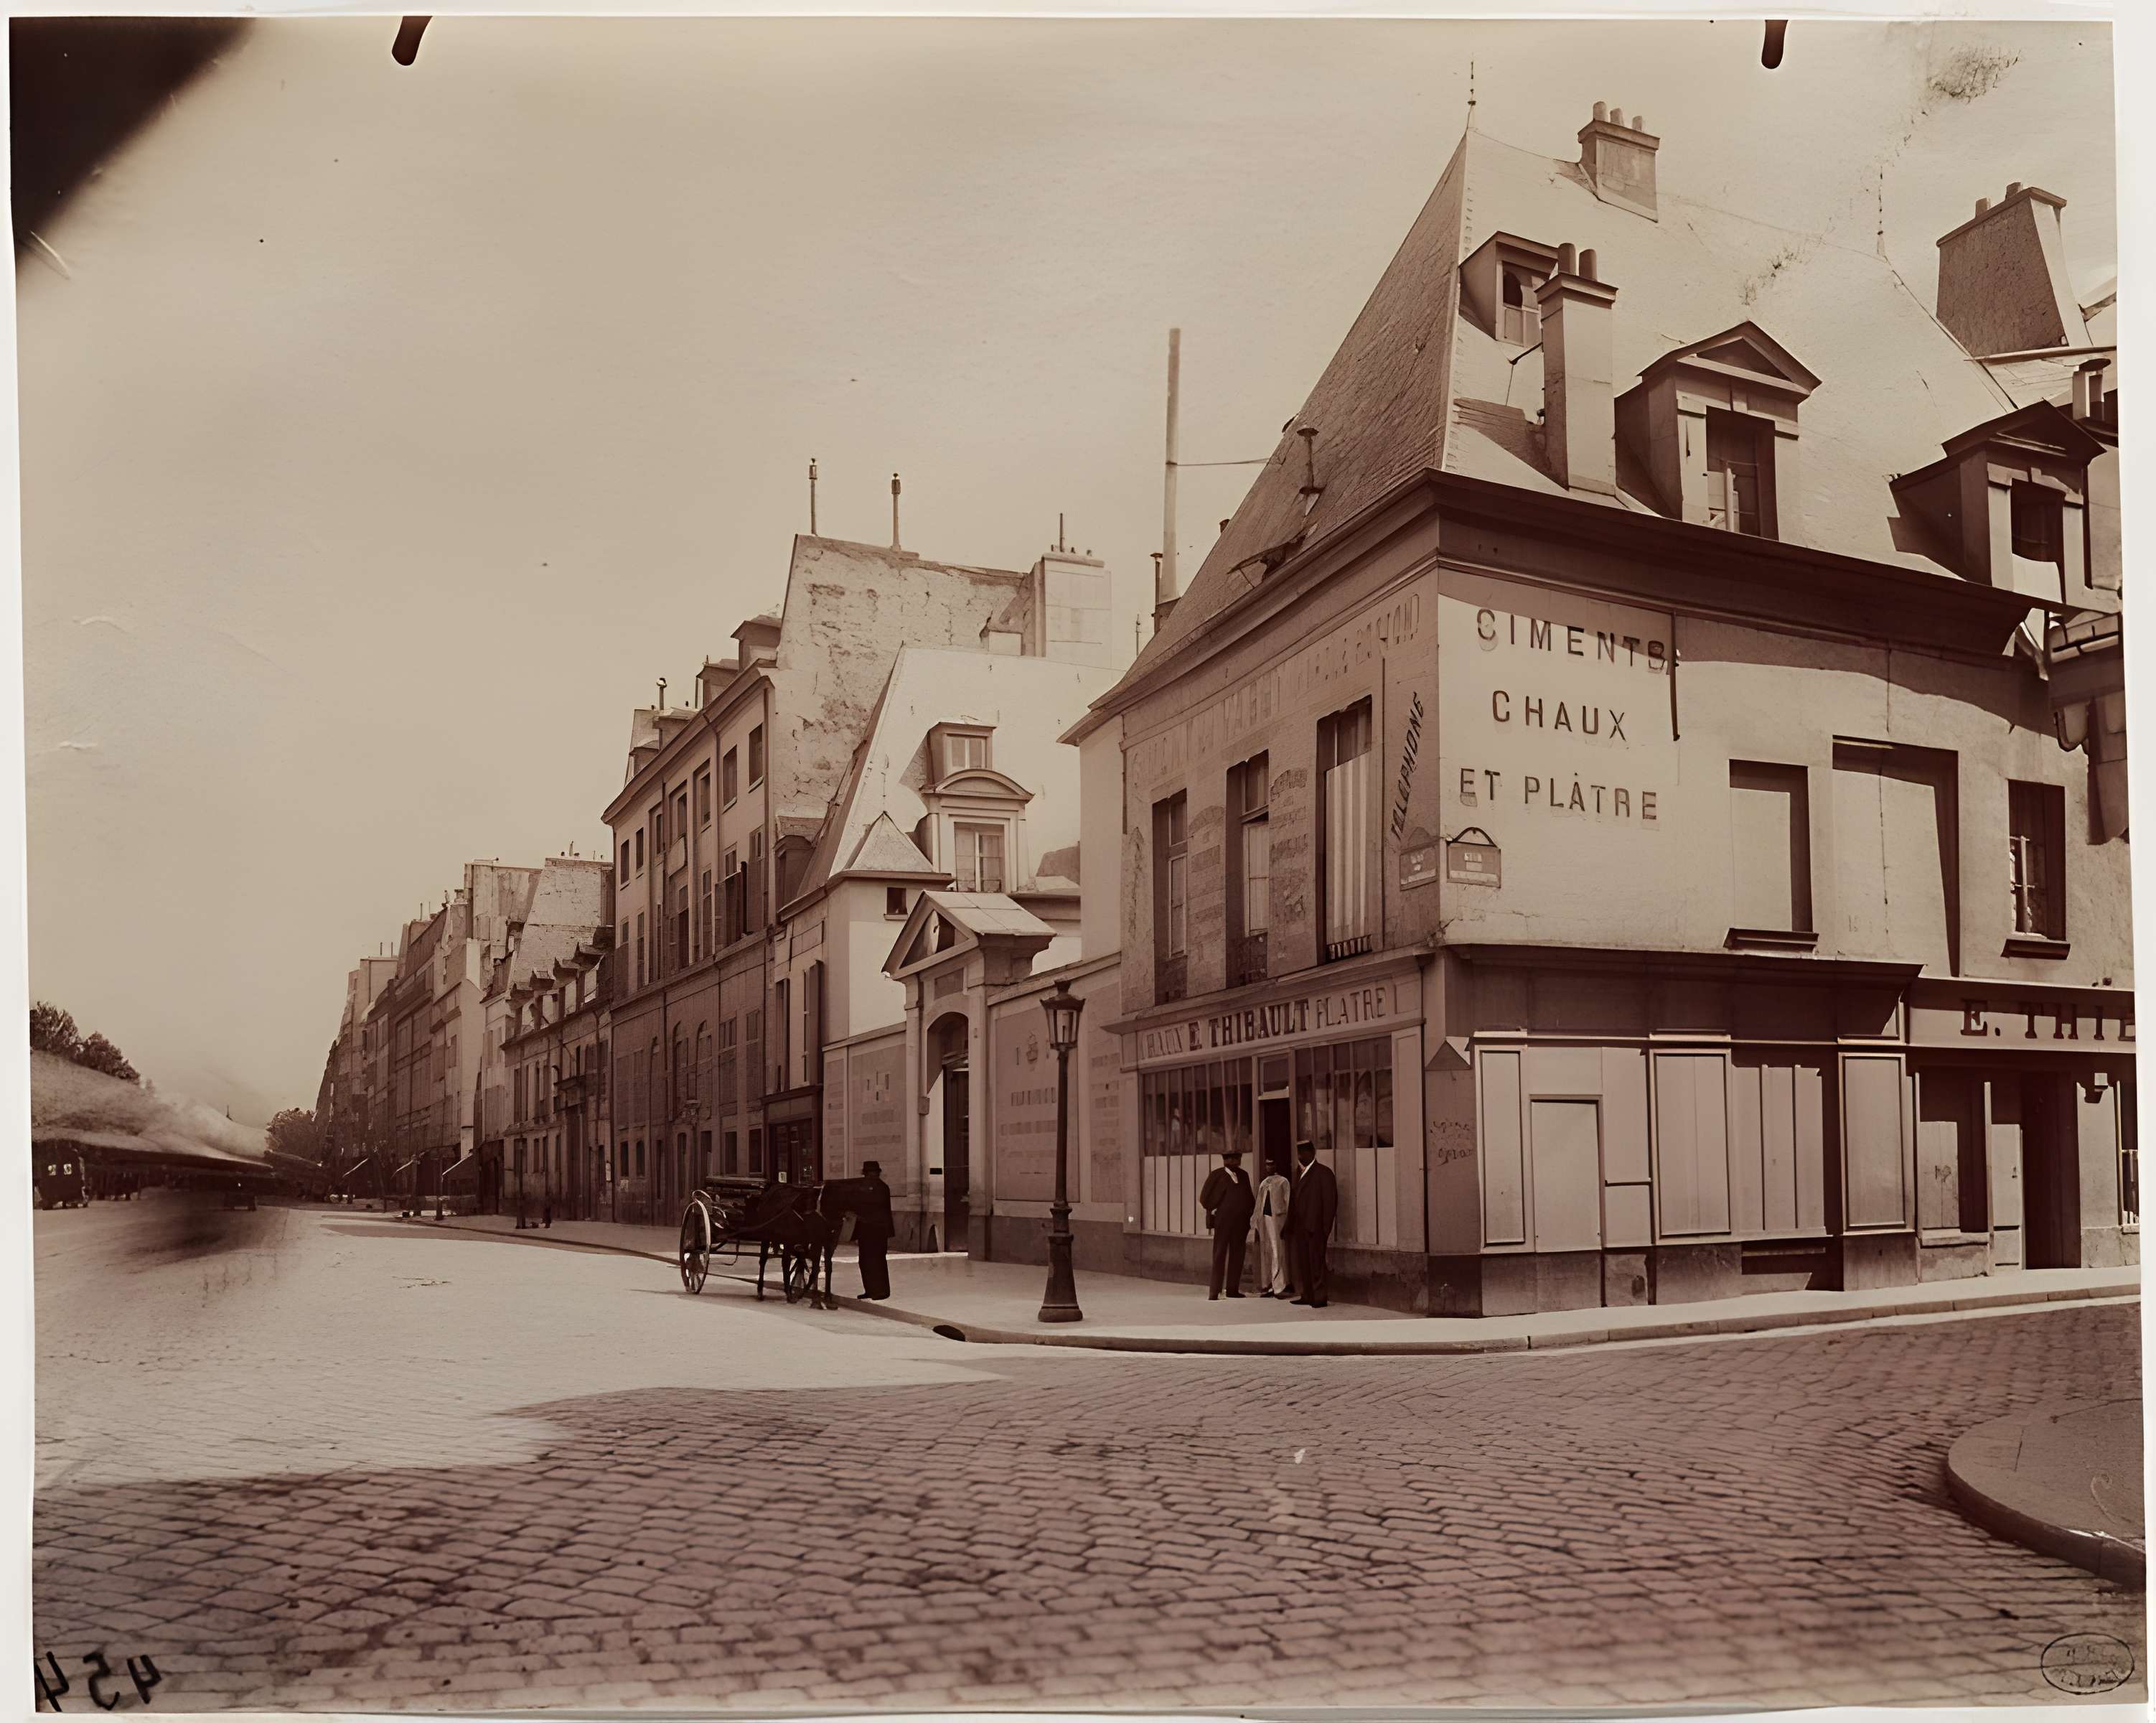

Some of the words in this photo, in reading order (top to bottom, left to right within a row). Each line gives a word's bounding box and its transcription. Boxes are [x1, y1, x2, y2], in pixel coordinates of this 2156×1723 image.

[1476, 608, 1666, 671] CIMENTS
[1492, 690, 1626, 742] CHAUX
[1460, 767, 1501, 800] ET
[1209, 998, 1309, 1047] THIBAULT
